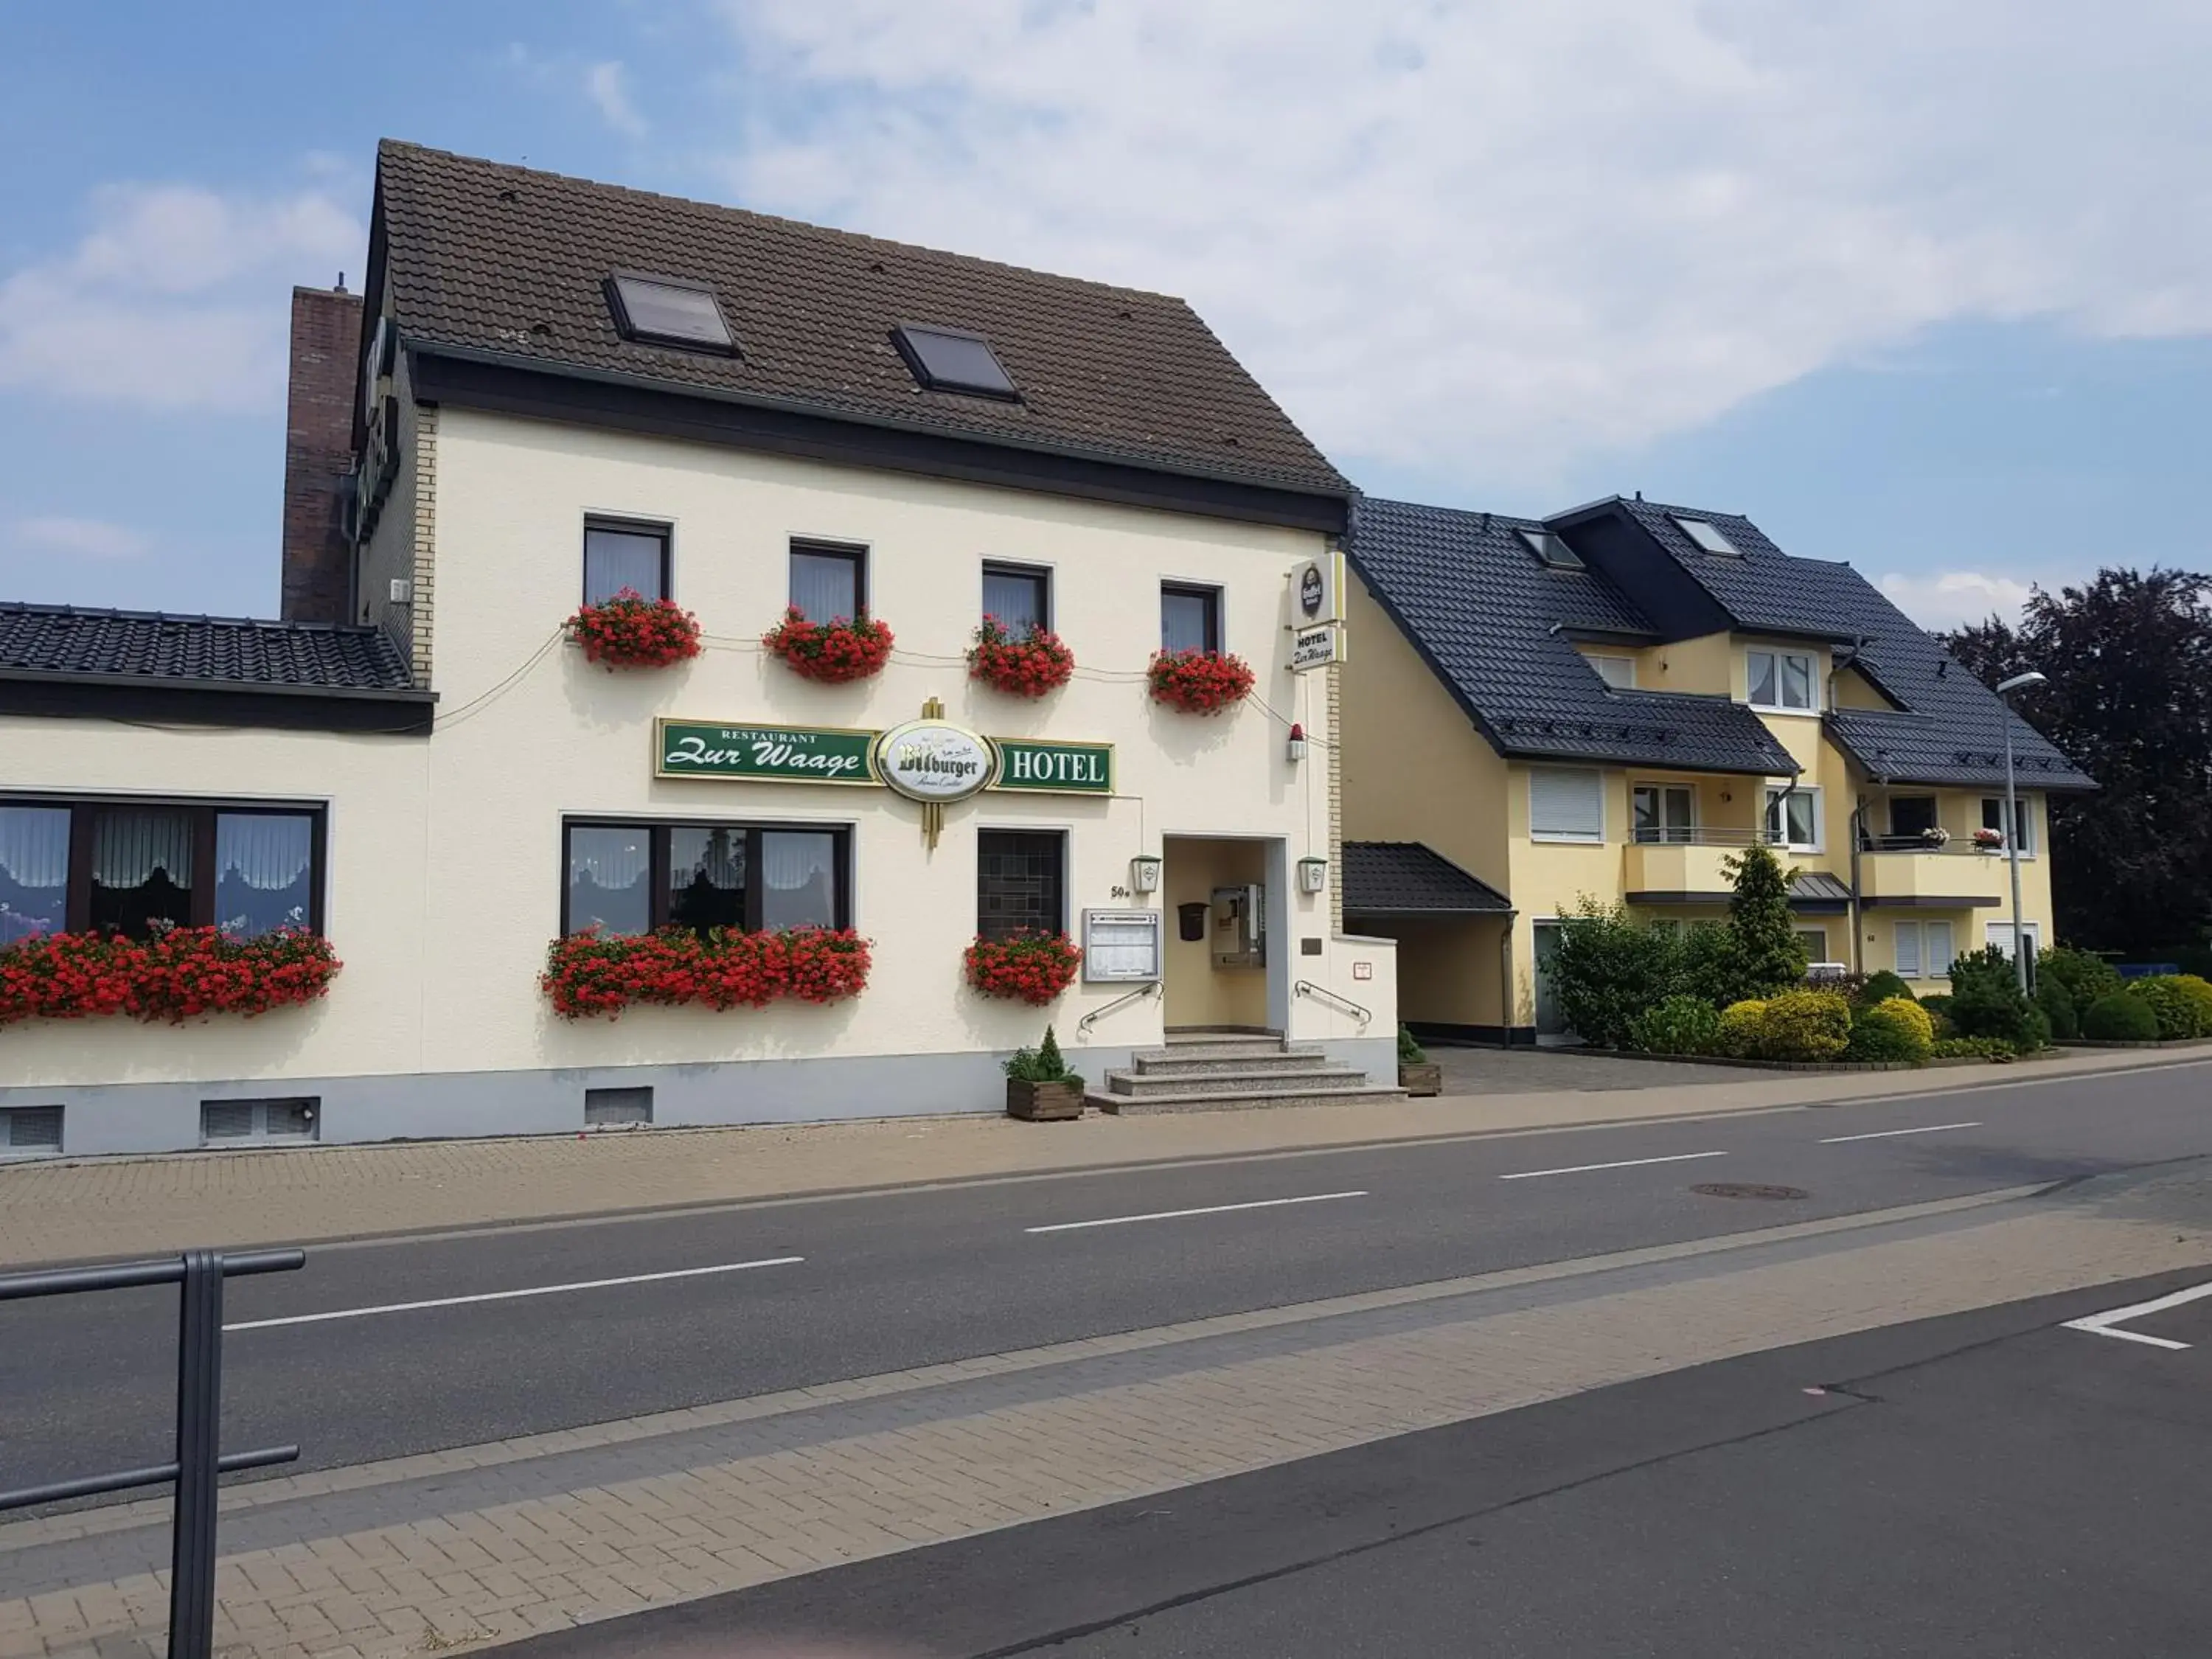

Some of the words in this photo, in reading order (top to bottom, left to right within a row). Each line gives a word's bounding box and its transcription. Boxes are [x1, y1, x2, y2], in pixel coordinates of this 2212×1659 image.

[1298, 631, 1327, 648] HOTEL
[722, 730, 818, 744] RESTAURANT
[666, 737, 742, 765] Zur
[751, 741, 860, 776] Waage
[898, 743, 978, 778] Bitburger
[1012, 751, 1105, 782] HOTEL
